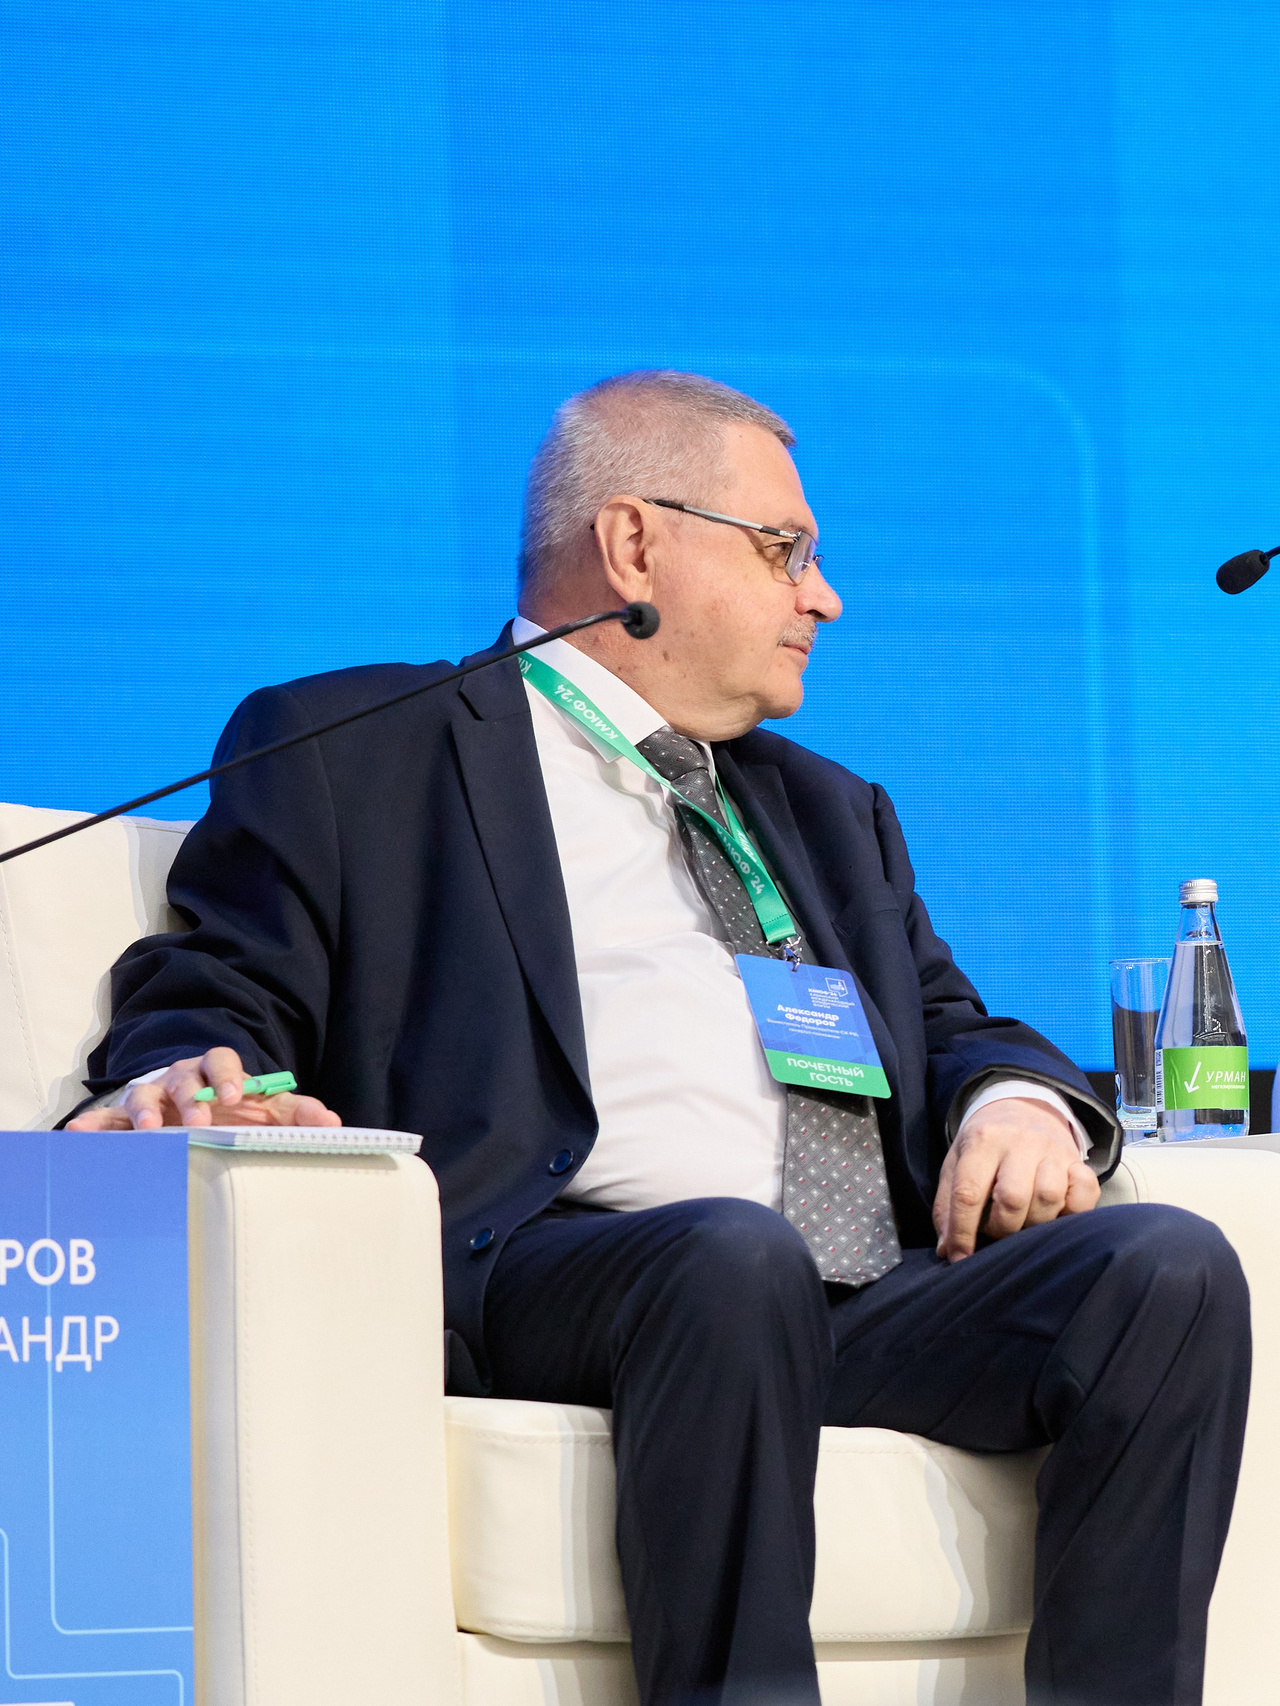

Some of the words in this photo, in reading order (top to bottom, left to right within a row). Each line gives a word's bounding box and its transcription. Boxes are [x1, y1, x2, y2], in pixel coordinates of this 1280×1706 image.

[554, 684, 619, 740] КМЮФ'24
[777, 1004, 839, 1021] Александр
[784, 1013, 836, 1027] Федоров
[786, 1057, 864, 1078] ПОЧЕТНЫЙ
[809, 1072, 854, 1087] ГОСТЬ
[1206, 1071, 1246, 1083] УРМАН
[0, 1238, 97, 1286] РОВ
